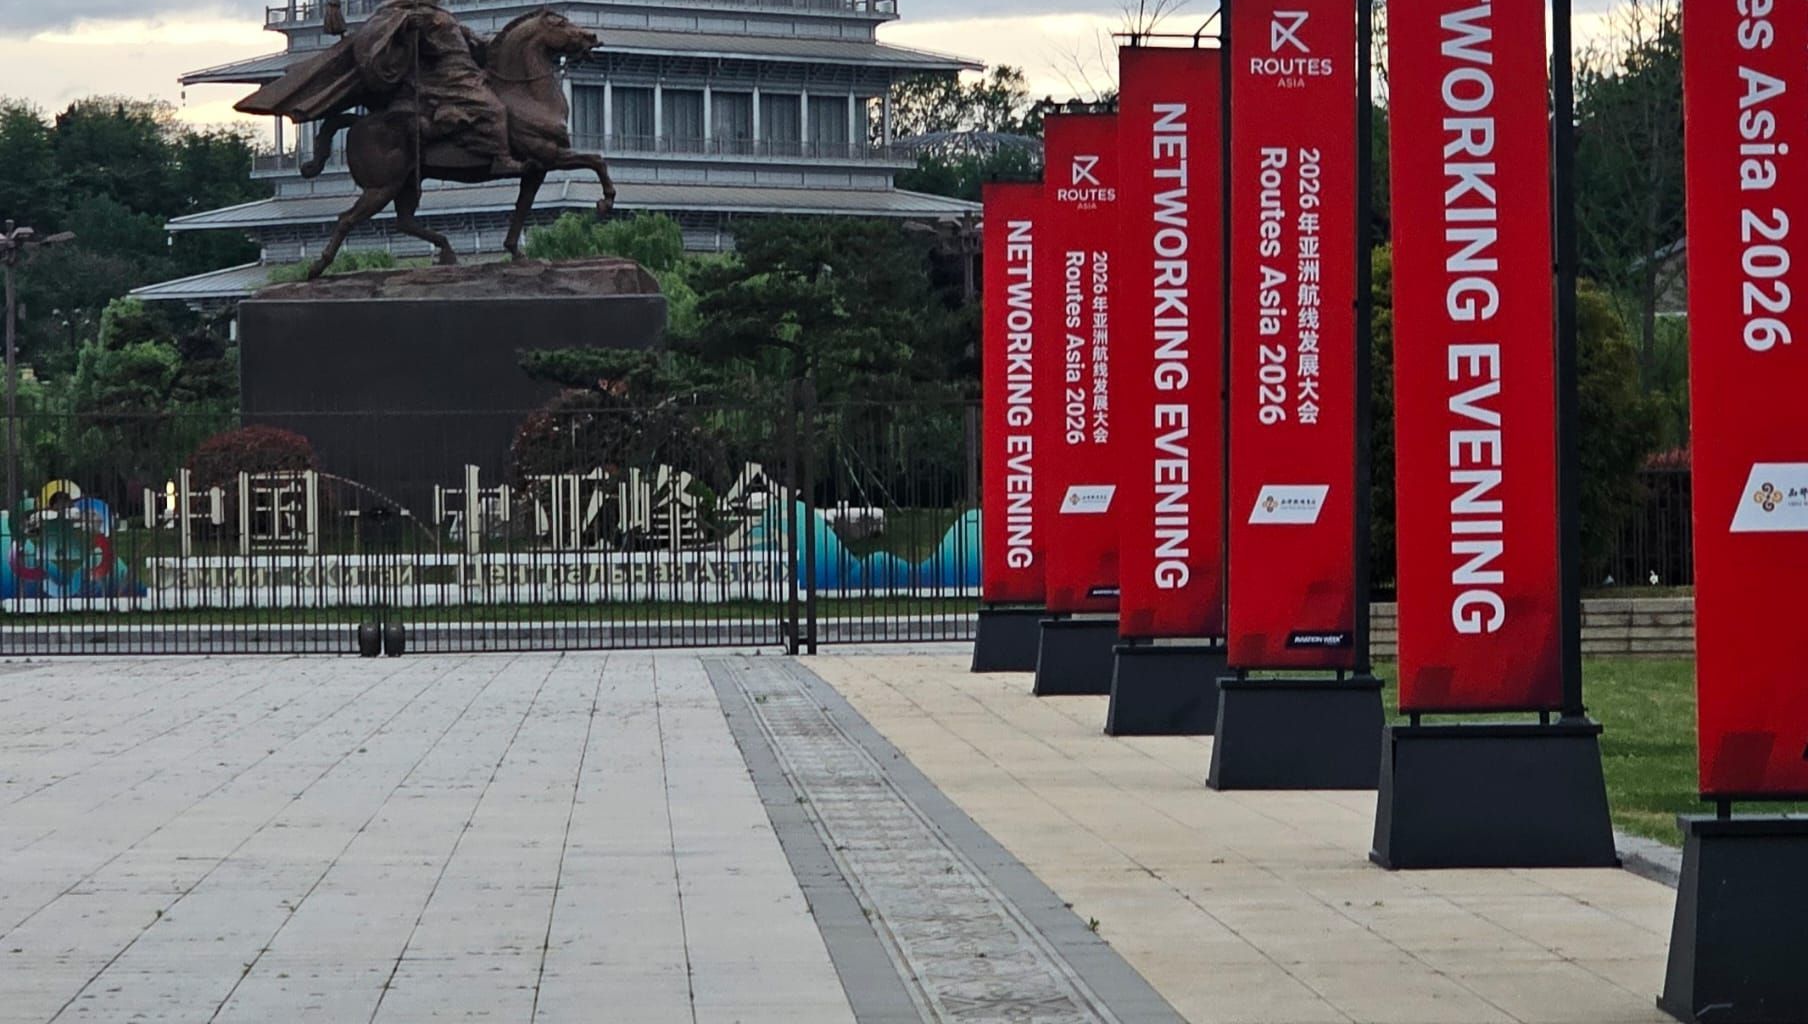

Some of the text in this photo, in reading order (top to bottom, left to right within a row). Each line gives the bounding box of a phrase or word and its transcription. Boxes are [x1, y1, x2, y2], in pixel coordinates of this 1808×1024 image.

[1250, 58, 1333, 75] ROUTES
[1278, 78, 1305, 88] ASIA
[1738, 66, 1789, 191] Asia
[1058, 188, 1116, 201] ROUTES
[1066, 251, 1086, 445] Routes Asia 2026
[1152, 103, 1190, 589] NETWORKING EVENING
[1259, 147, 1287, 425] Routes Asia 2026
[1741, 208, 1792, 352] 2026
[1006, 220, 1033, 568] NETWORKING EVENING
[1447, 343, 1506, 634] EVENING
